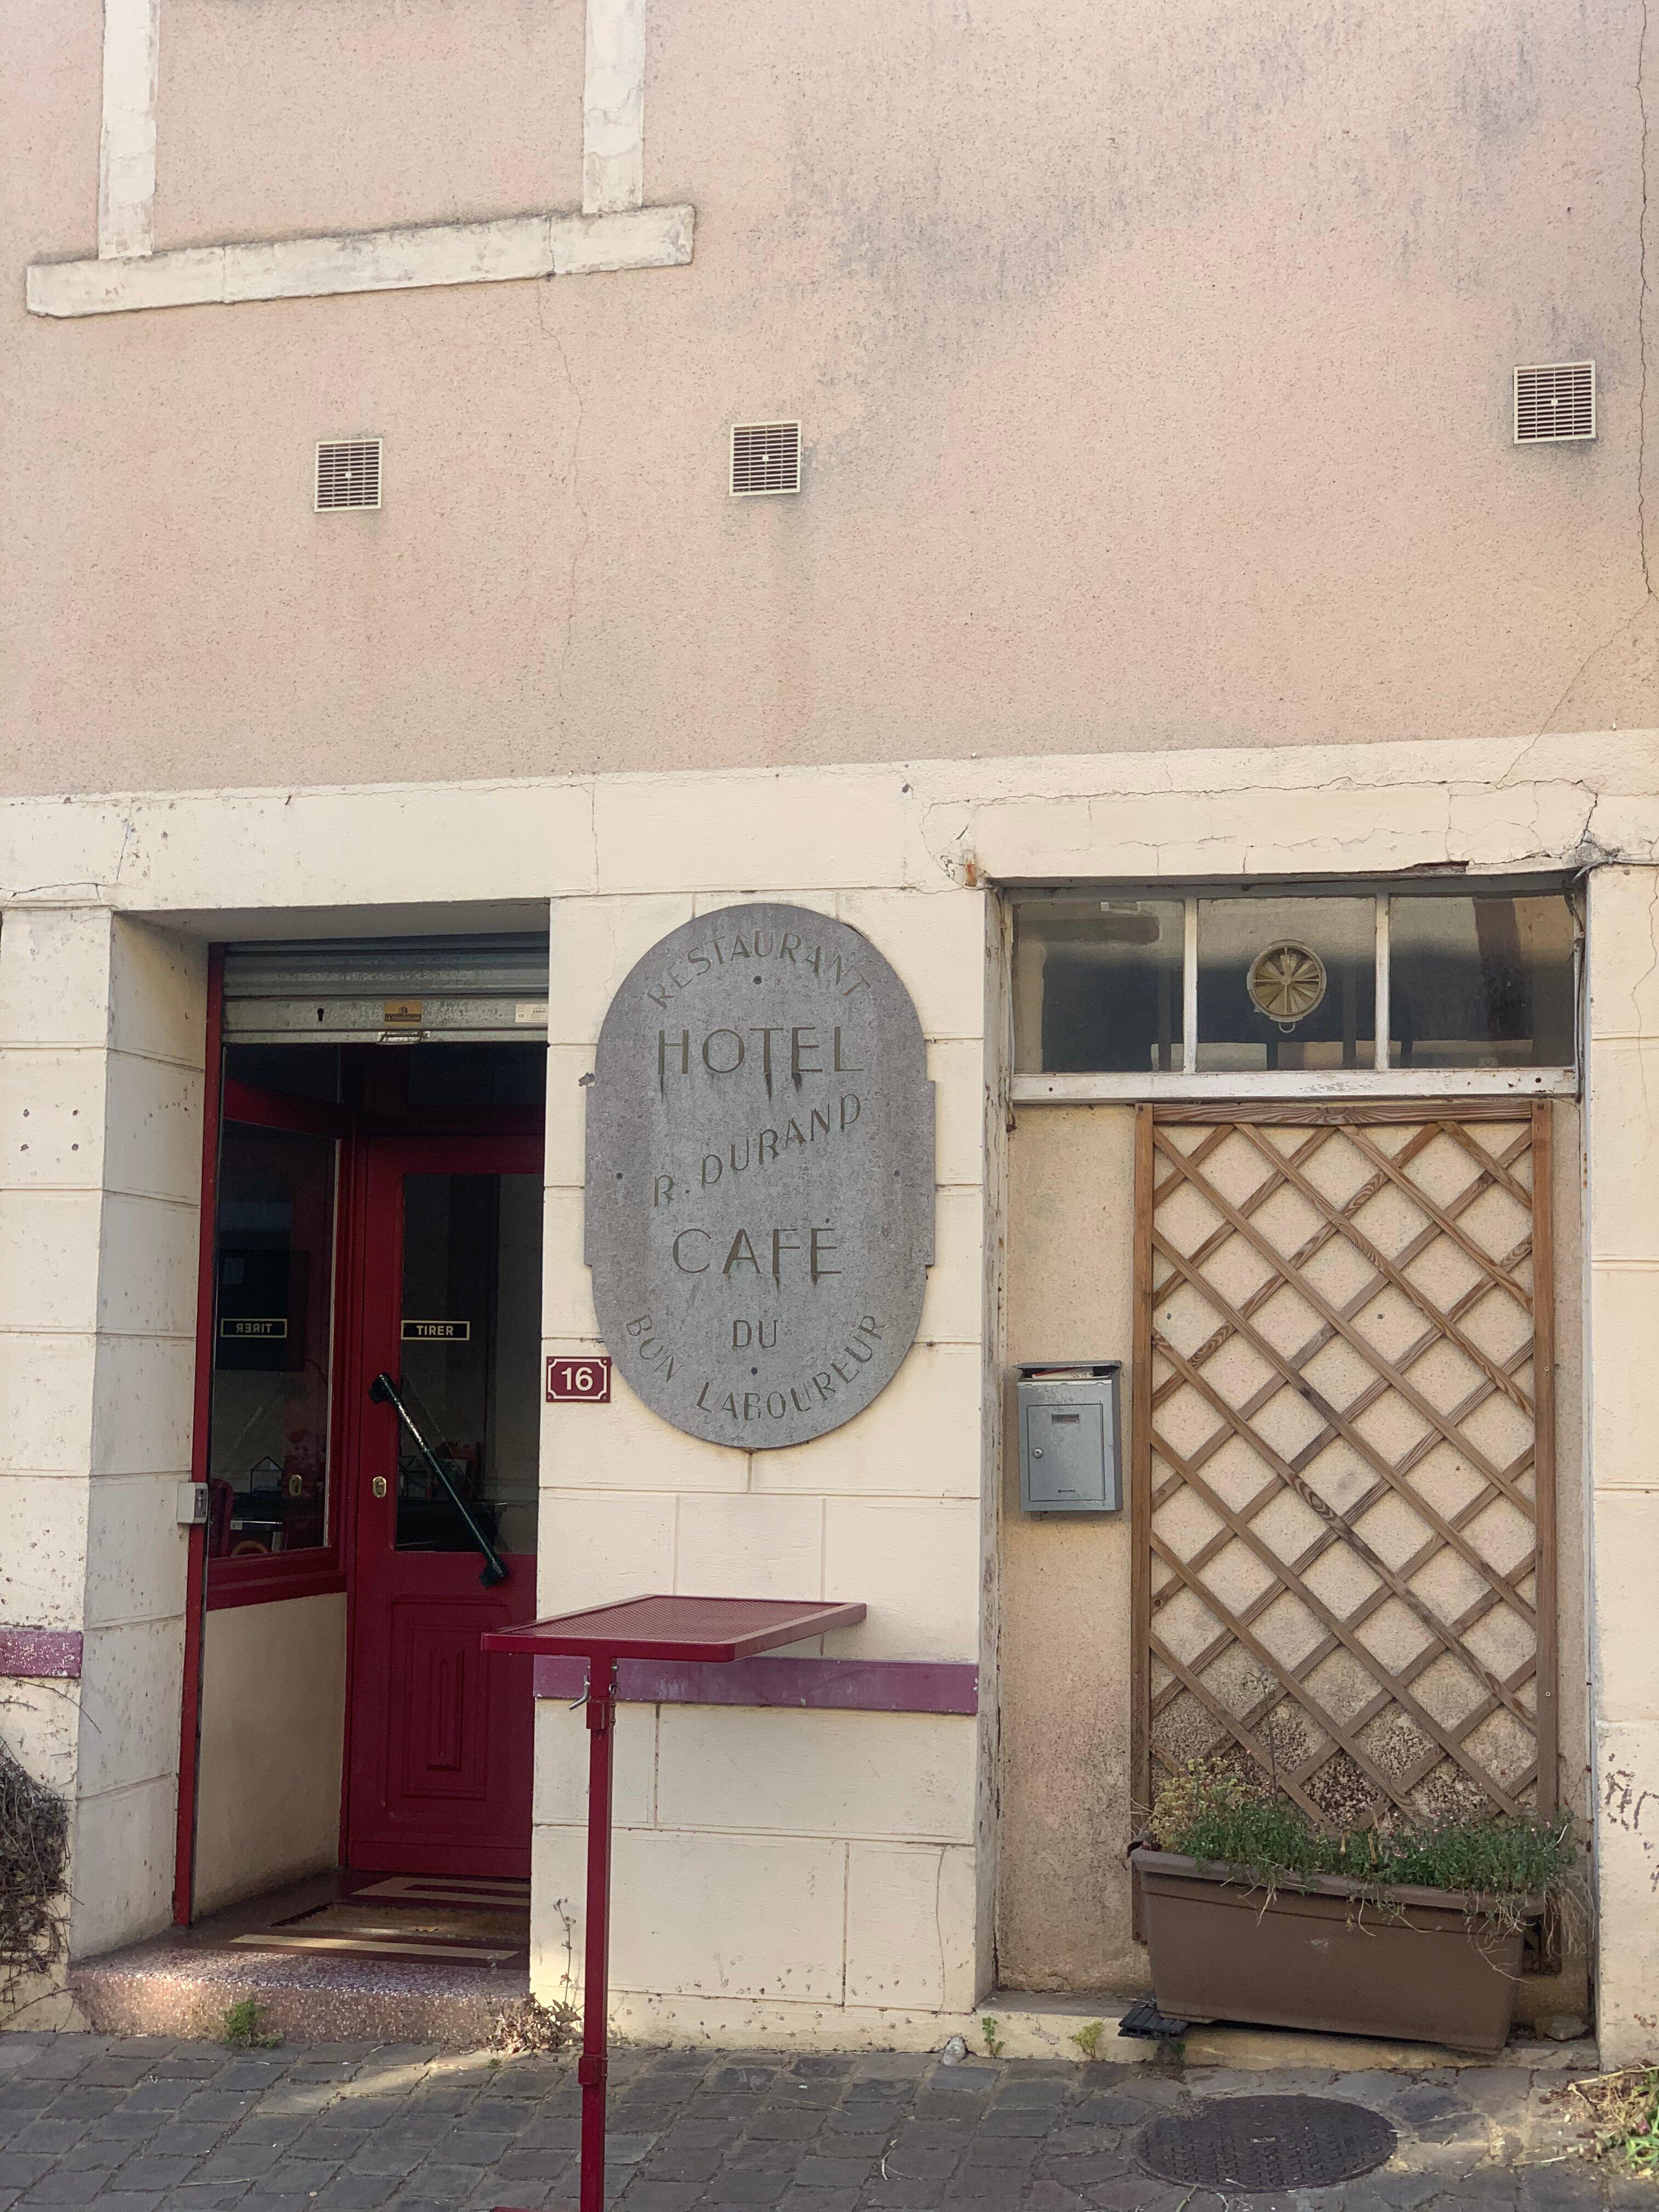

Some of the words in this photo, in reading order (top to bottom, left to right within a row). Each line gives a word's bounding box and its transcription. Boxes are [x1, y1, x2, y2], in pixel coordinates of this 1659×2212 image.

[647, 930, 871, 1008] RESTAURANT
[658, 1026, 864, 1075] HOTEL
[702, 1092, 861, 1189] DURAND
[416, 1325, 454, 1336] TIRER
[731, 1319, 778, 1348] DU
[561, 1367, 593, 1391] 16
[625, 1314, 684, 1384] BON
[695, 1315, 884, 1421] LABOUREUR
